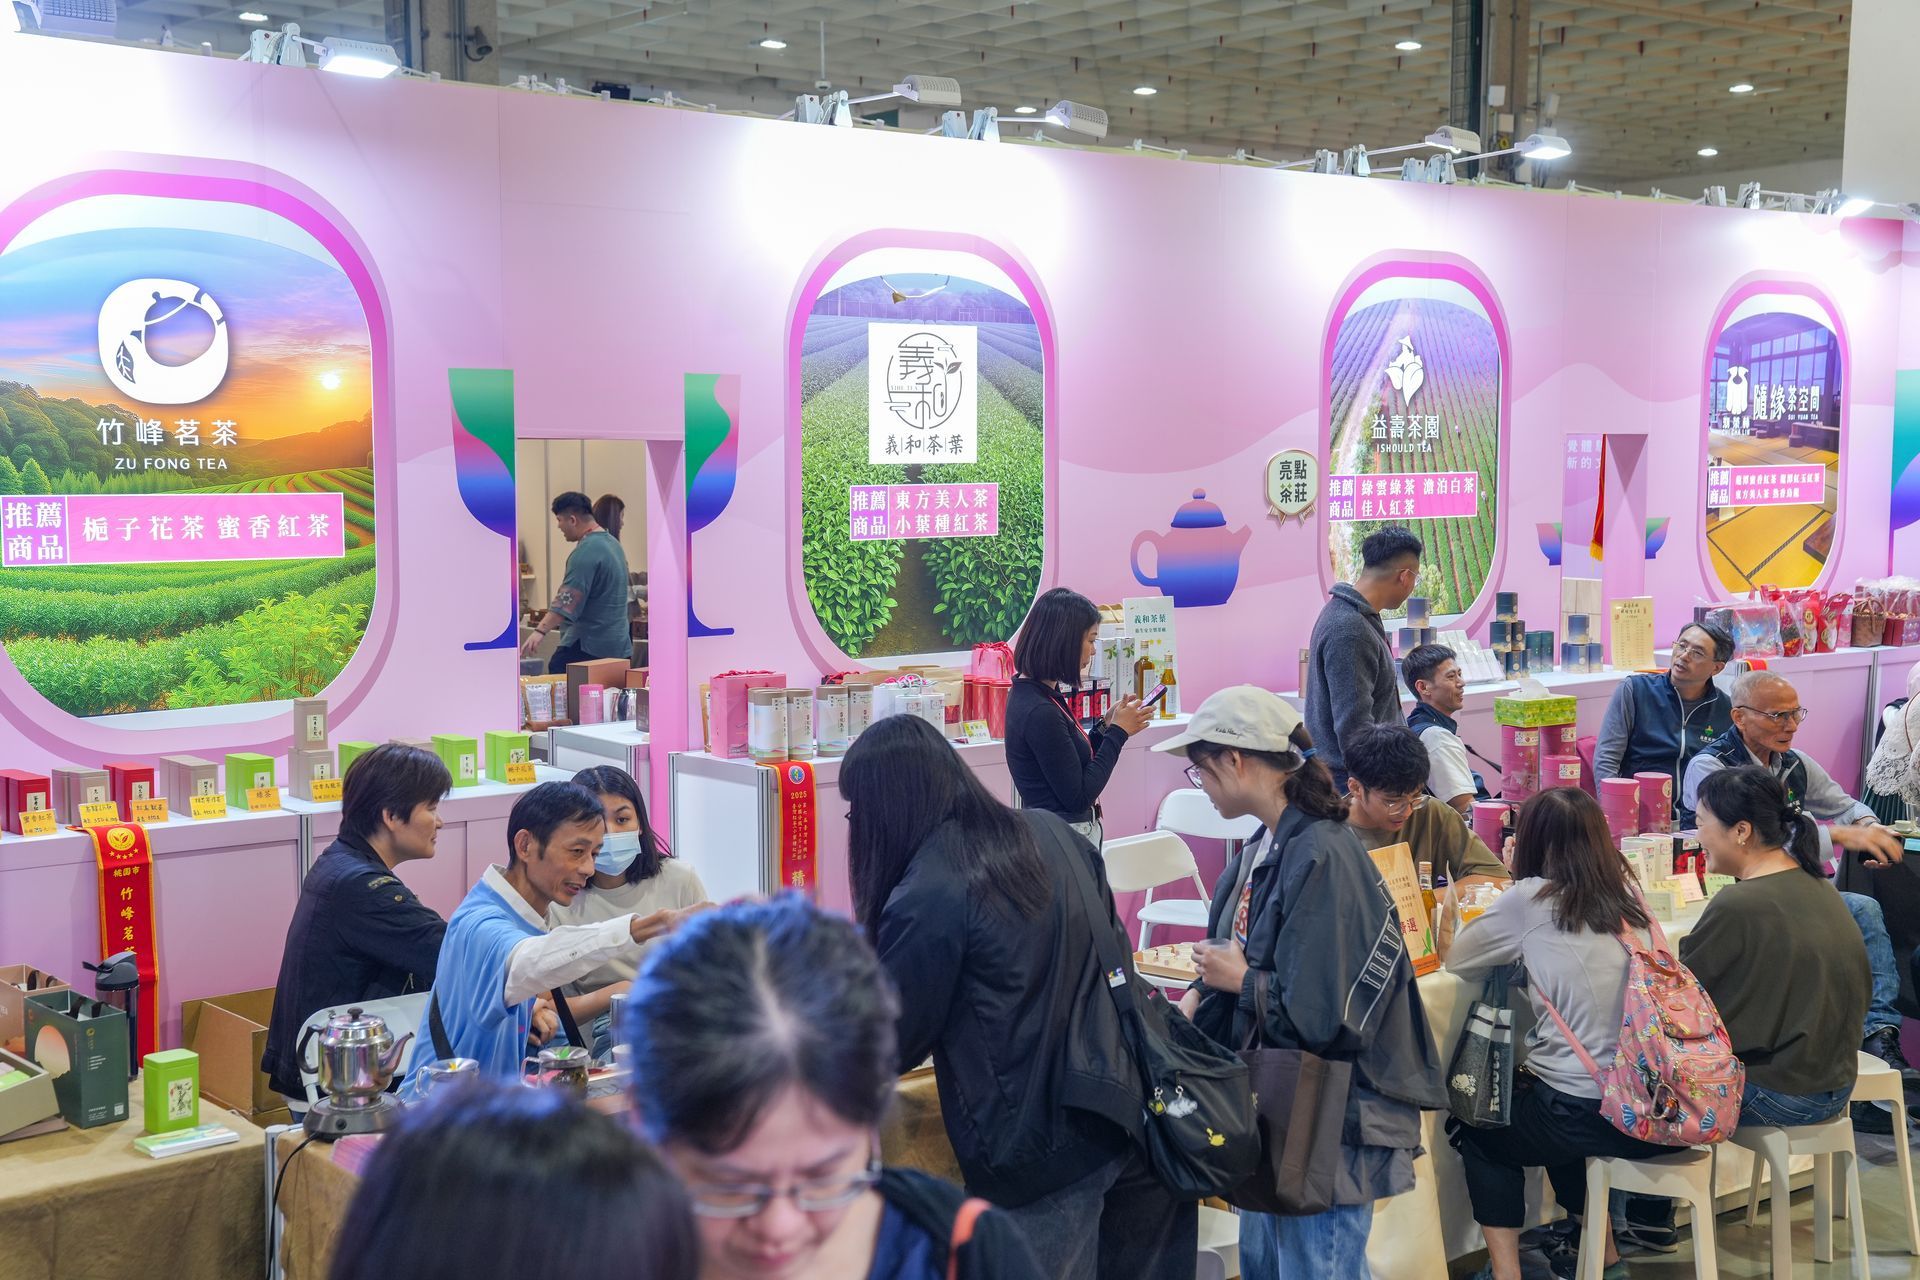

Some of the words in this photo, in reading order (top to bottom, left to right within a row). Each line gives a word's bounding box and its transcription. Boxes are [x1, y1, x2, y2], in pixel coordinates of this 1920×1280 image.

[96, 418, 238, 447] 竹峰茗茶
[1371, 414, 1440, 440] 益壽茶園
[1377, 444, 1414, 453] ISHOULD
[1417, 443, 1433, 453] TEA
[114, 457, 137, 470] ZU
[144, 457, 191, 470] FONG
[196, 457, 228, 470] TEA
[1280, 460, 1308, 480] 亮點
[1280, 482, 1308, 504] 茶莊
[1329, 479, 1354, 497] 推薦
[1361, 478, 1416, 496] 綠雲綠茶
[1709, 489, 1729, 505] 商品
[852, 490, 887, 511] 推薦
[895, 488, 988, 510] 東方美人茶
[1361, 498, 1416, 518] 佳人紅茶
[5, 502, 63, 529] 推薦
[1329, 501, 1354, 518] 商品
[82, 515, 205, 542] 梔子花茶
[216, 513, 331, 540] 蜜香紅茶
[852, 516, 886, 536] 商品
[895, 512, 988, 535] 小葉種紅茶
[7, 535, 64, 561] 商品
[1134, 614, 1167, 624] 義和茶葉
[790, 791, 808, 799] 2025
[113, 866, 141, 877] 桃園市
[1361, 950, 1393, 990] THE
